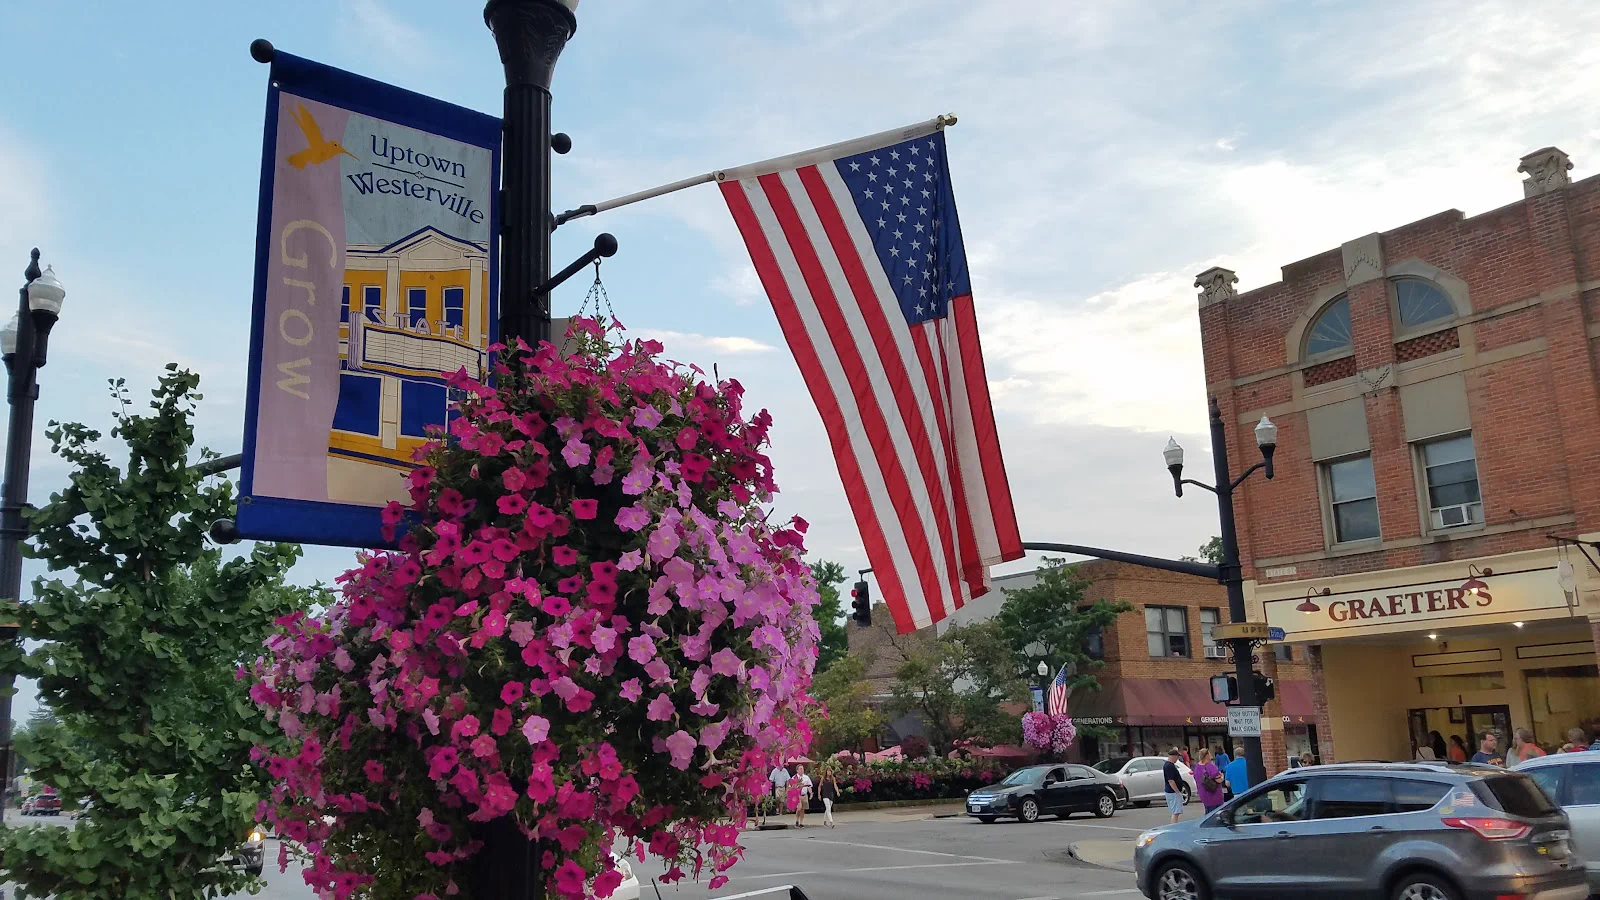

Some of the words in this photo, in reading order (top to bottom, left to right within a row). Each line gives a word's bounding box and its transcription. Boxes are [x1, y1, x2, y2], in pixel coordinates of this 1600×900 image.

[371, 134, 466, 178] Uptown
[346, 172, 484, 224] Westerville
[276, 219, 337, 400] Grow
[372, 308, 465, 342] STATE
[1328, 585, 1493, 622] GRAETER'S
[1072, 717, 1113, 725] GENERATIONS
